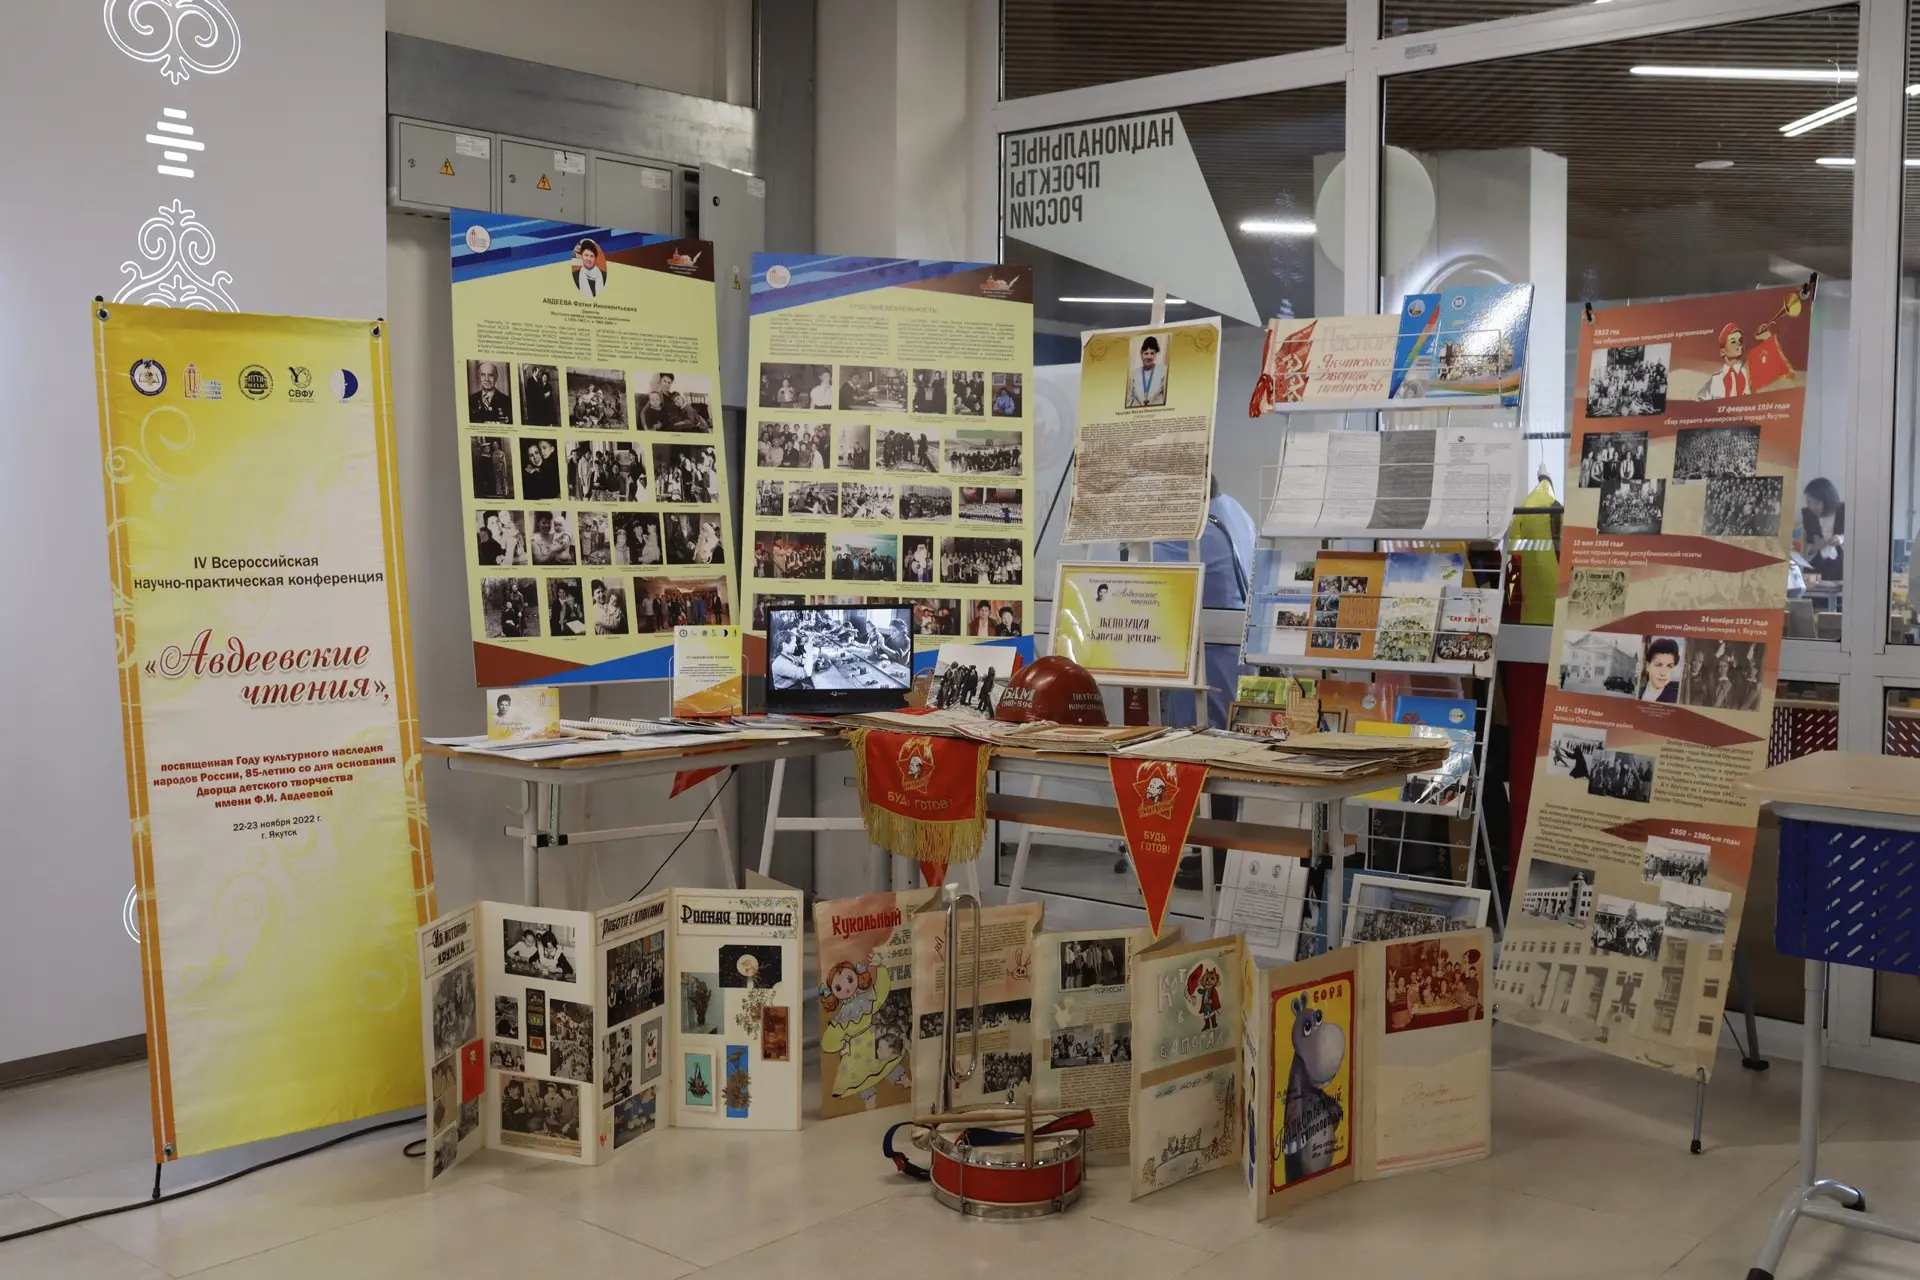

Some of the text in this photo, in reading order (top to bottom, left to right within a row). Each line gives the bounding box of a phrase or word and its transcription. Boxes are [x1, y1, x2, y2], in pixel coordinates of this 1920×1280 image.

[288, 389, 314, 398] СВФУ
[194, 555, 319, 571] IV Всероссийская
[134, 572, 384, 592] научно-практическая конференция
[145, 628, 370, 677] «Авдеевские
[240, 677, 390, 706] чтения»,
[1002, 687, 1037, 700] БАМ
[161, 744, 384, 772] посвященная Году культурного наследия
[153, 755, 396, 787] народов России, 85-летию со дня основания
[196, 773, 353, 797] Дворца детского творчества
[214, 787, 333, 809] имени Ф.И. Авдеевой
[233, 814, 323, 832] 22-23 ноября 2022 г.
[261, 828, 298, 840] г. Якутск
[1143, 830, 1166, 842] БУДЬ
[1670, 828, 1687, 837] 1950
[1141, 841, 1170, 853] ГОТОВ!
